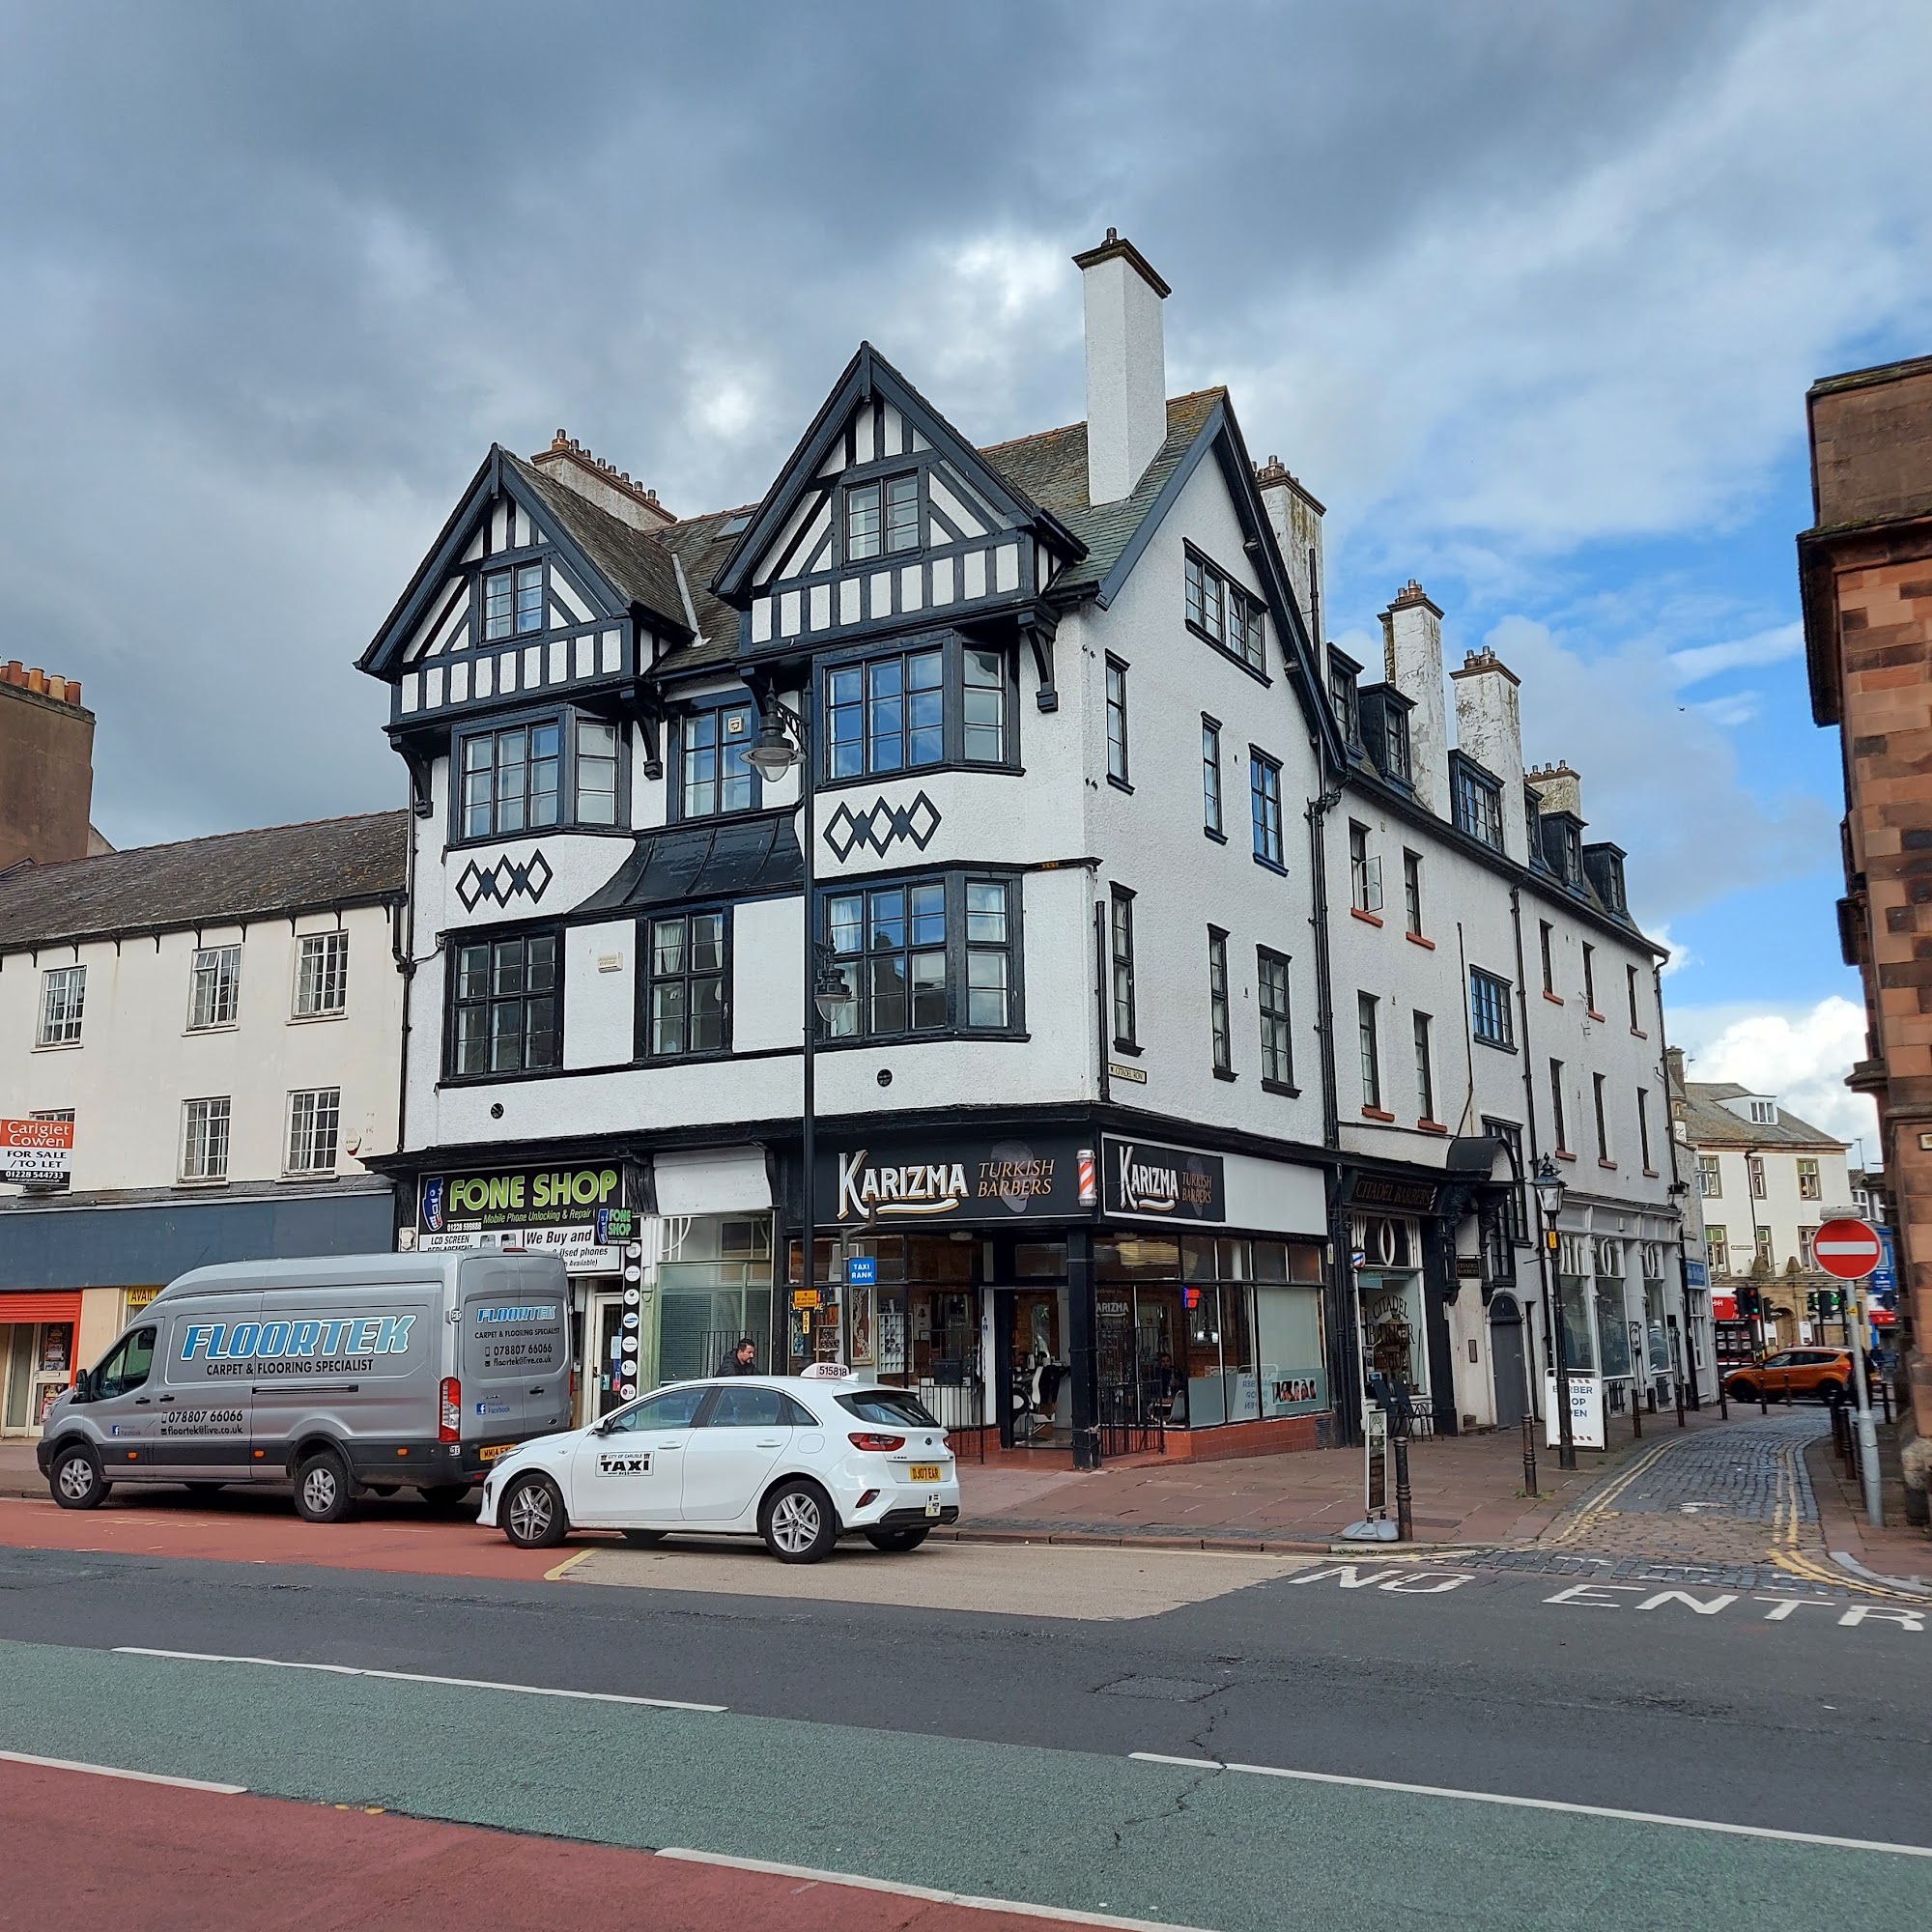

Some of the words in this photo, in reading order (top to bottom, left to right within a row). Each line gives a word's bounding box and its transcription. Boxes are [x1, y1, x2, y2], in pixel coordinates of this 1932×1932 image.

[1116, 1067, 1132, 1078] CITADEL
[7, 1122, 70, 1137] Carigiet
[9, 1134, 64, 1147] Cowen
[978, 1159, 1055, 1179] TURKISH
[1182, 1172, 1212, 1188] TURKISH
[449, 1175, 525, 1212] FONE
[533, 1170, 617, 1207] SHOP
[977, 1178, 1052, 1198] BARBERS
[1356, 1180, 1393, 1202] CITADEL
[1394, 1184, 1432, 1206] BARBERS
[1182, 1188, 1212, 1204] BARBERS
[483, 1214, 505, 1224] Mobile
[506, 1212, 527, 1223] Phone
[528, 1209, 560, 1222] Unlocking
[562, 1209, 568, 1218] &
[569, 1208, 591, 1221] Repair
[609, 1209, 631, 1222] FONE
[608, 1222, 631, 1236] SHOP
[431, 1236, 444, 1245] LCD
[444, 1235, 470, 1244] SCREEN
[526, 1232, 542, 1245] We
[546, 1231, 568, 1246] Buy
[570, 1229, 592, 1242] and
[560, 1248, 578, 1257] Used
[580, 1248, 608, 1258] phones
[477, 1306, 556, 1323] FLOORTEK
[1372, 1295, 1409, 1319] CITADEL
[180, 1314, 417, 1361] FLOORTEK
[475, 1330, 497, 1339] CARPET
[535, 1328, 560, 1336] SPECIALIST
[494, 1345, 526, 1356] 078807
[528, 1344, 552, 1354] 66066
[207, 1364, 243, 1375] CARPET
[246, 1364, 254, 1374] &
[258, 1361, 312, 1374] FLOORING
[316, 1359, 373, 1372] SPECIALIST
[819, 1366, 847, 1376] 515818
[169, 1411, 207, 1423] 078807
[210, 1410, 243, 1422] 66066
[168, 1424, 243, 1435] floortek@live.co.uk
[600, 1460, 649, 1471] TAXI
[1286, 1565, 1477, 1593] NO
